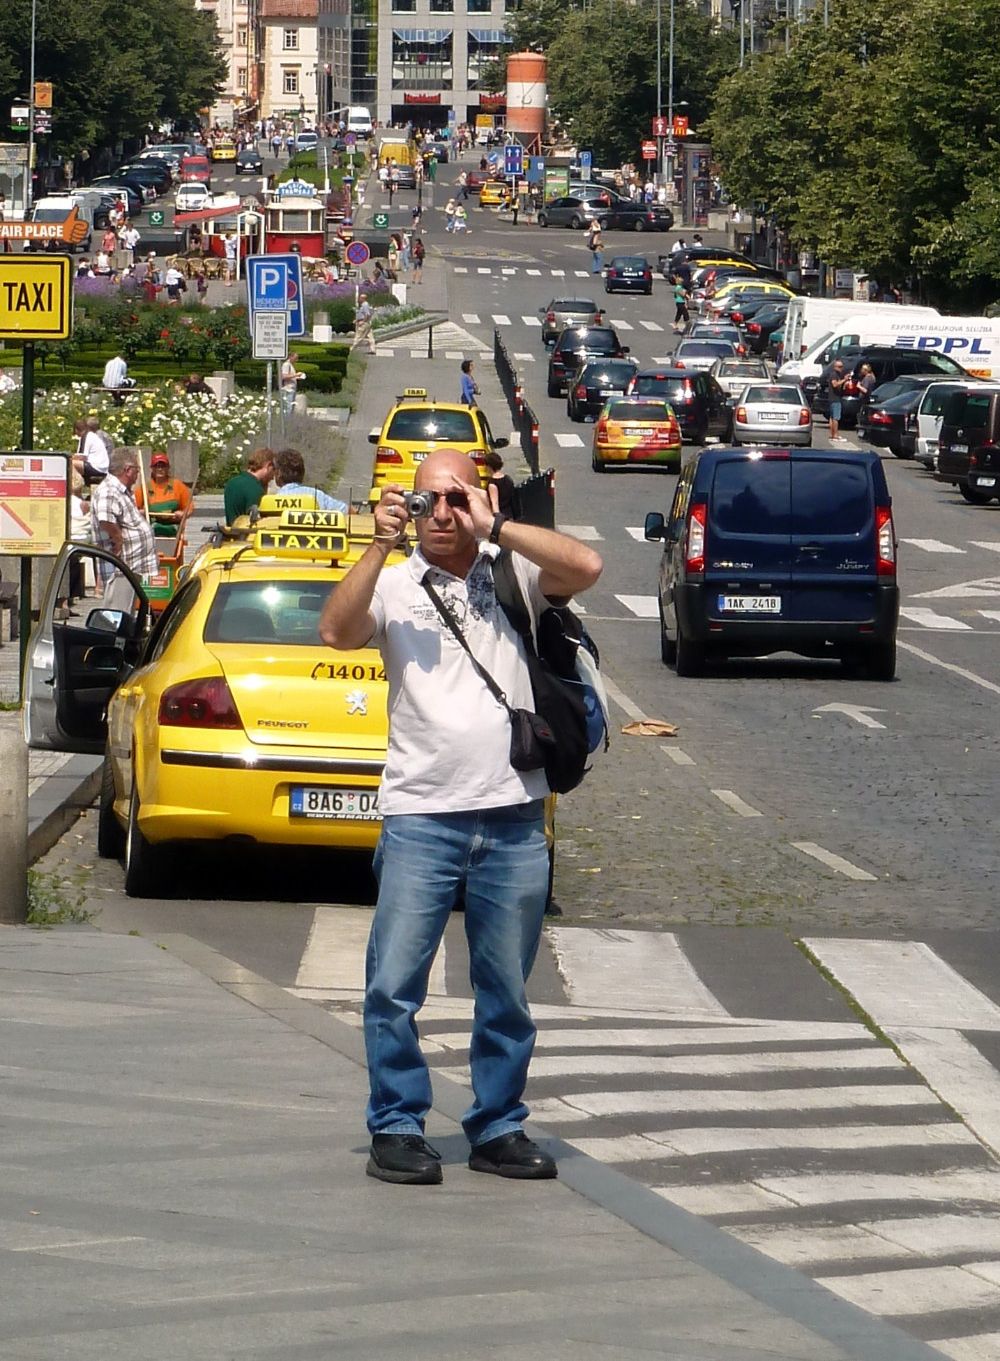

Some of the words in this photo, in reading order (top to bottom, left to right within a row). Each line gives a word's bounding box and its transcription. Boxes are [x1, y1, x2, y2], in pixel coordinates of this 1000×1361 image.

[24, 225, 64, 238] PLACE
[261, 268, 280, 296] P
[3, 282, 53, 312] TAXI
[917, 336, 992, 354] PPL
[275, 498, 302, 508] TAXI
[290, 512, 337, 526] TAXI
[270, 534, 333, 550] TAXI
[727, 598, 745, 609] 1AK
[257, 719, 310, 729] PEUGEOT
[308, 791, 343, 811] 8A6
